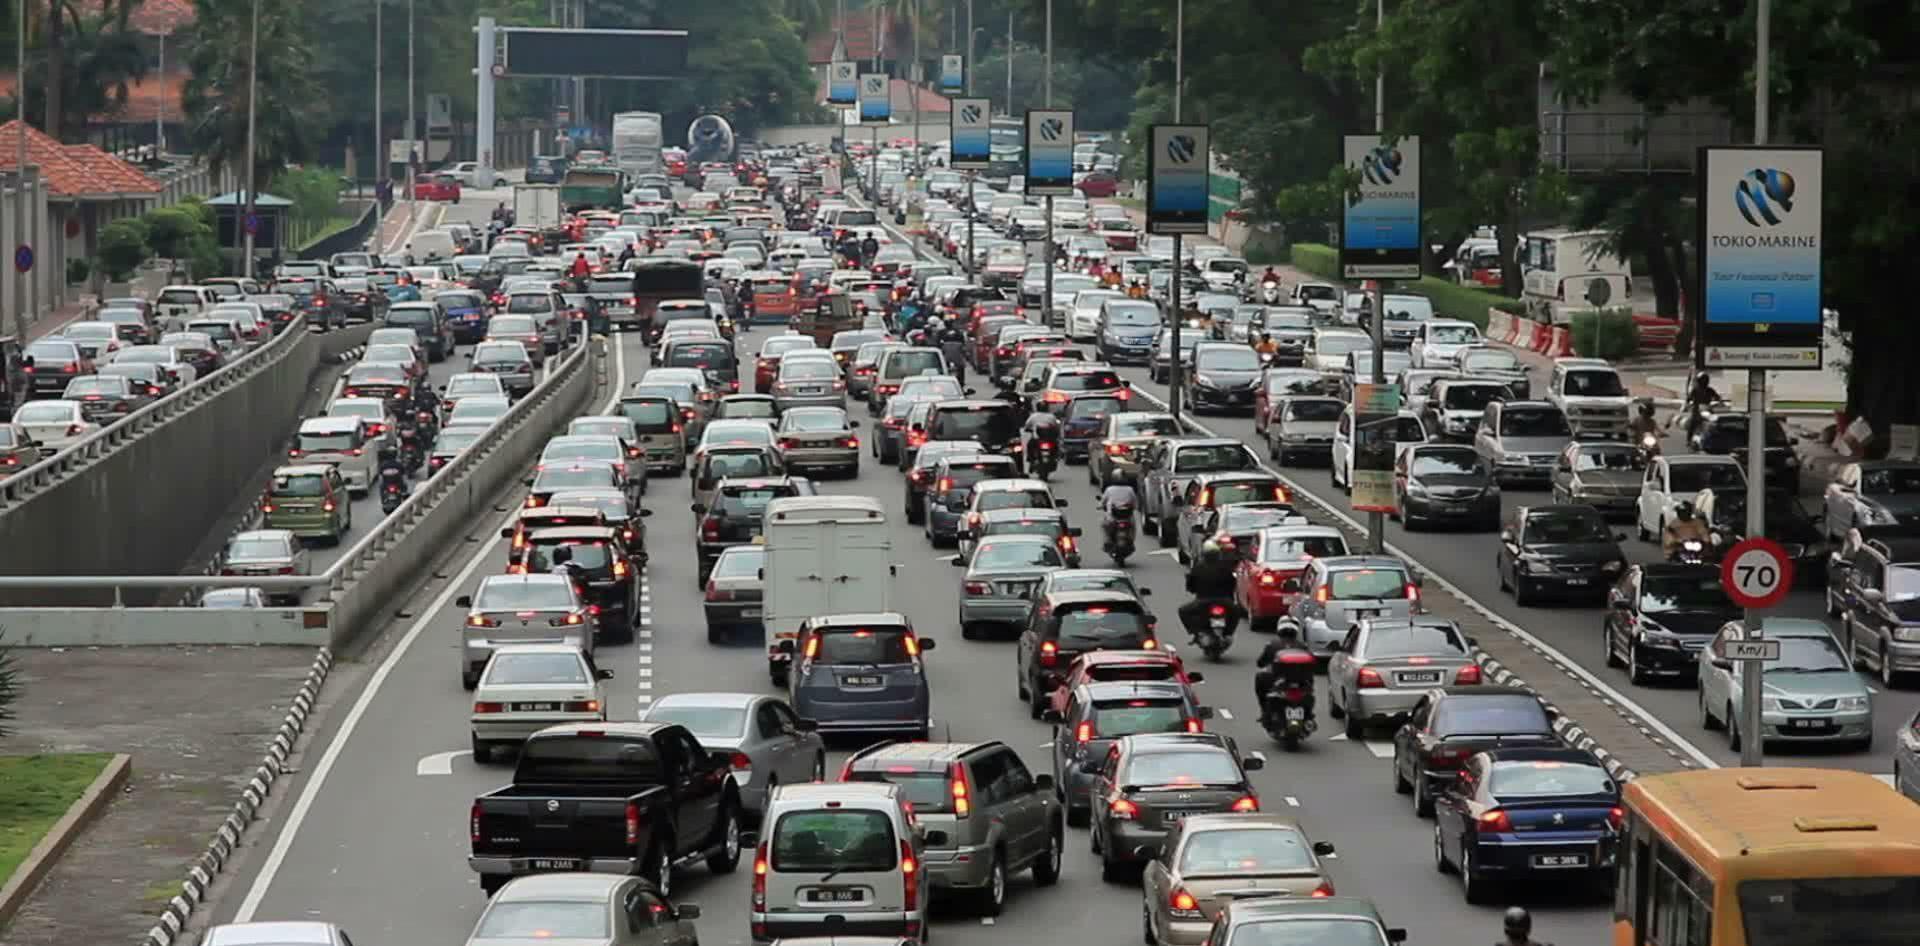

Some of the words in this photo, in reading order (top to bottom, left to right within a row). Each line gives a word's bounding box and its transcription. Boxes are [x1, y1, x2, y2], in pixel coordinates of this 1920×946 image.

[1712, 235, 1756, 248] TOKIO
[1758, 235, 1817, 248] MARINE
[1737, 565, 1776, 588] 70
[1737, 644, 1768, 658] Km/j
